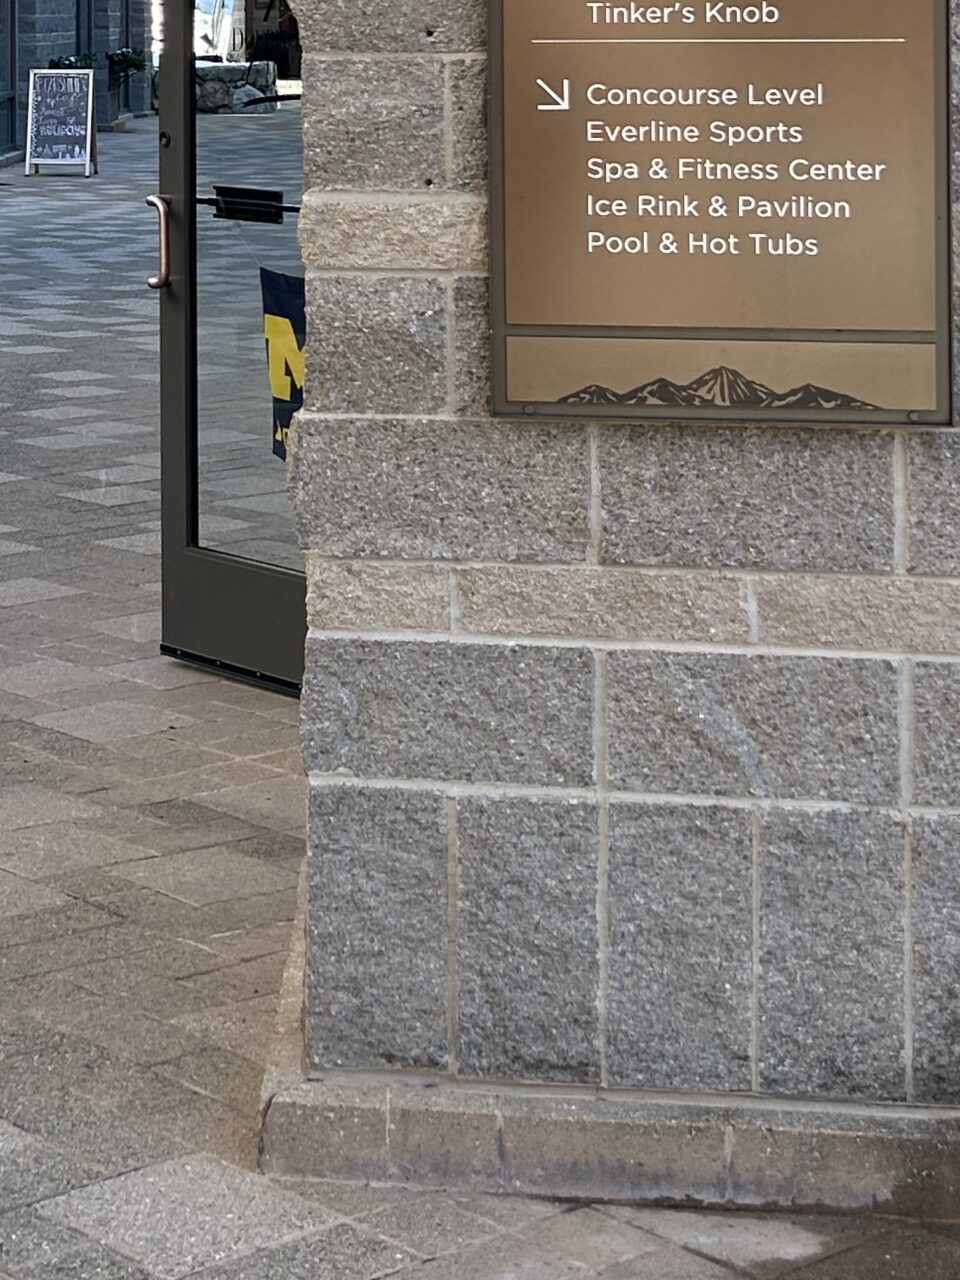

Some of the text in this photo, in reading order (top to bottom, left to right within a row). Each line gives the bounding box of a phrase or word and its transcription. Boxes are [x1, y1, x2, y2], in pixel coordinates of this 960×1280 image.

[586, 0, 779, 24] Tinker's Knob
[586, 83, 823, 106] Concourse Level
[586, 120, 803, 147] Everline Sports
[587, 157, 887, 183] Spa & Fitness Center
[587, 194, 850, 218] Ice Rink & Pavilion
[588, 231, 818, 256] Pool & Hot Tubs
